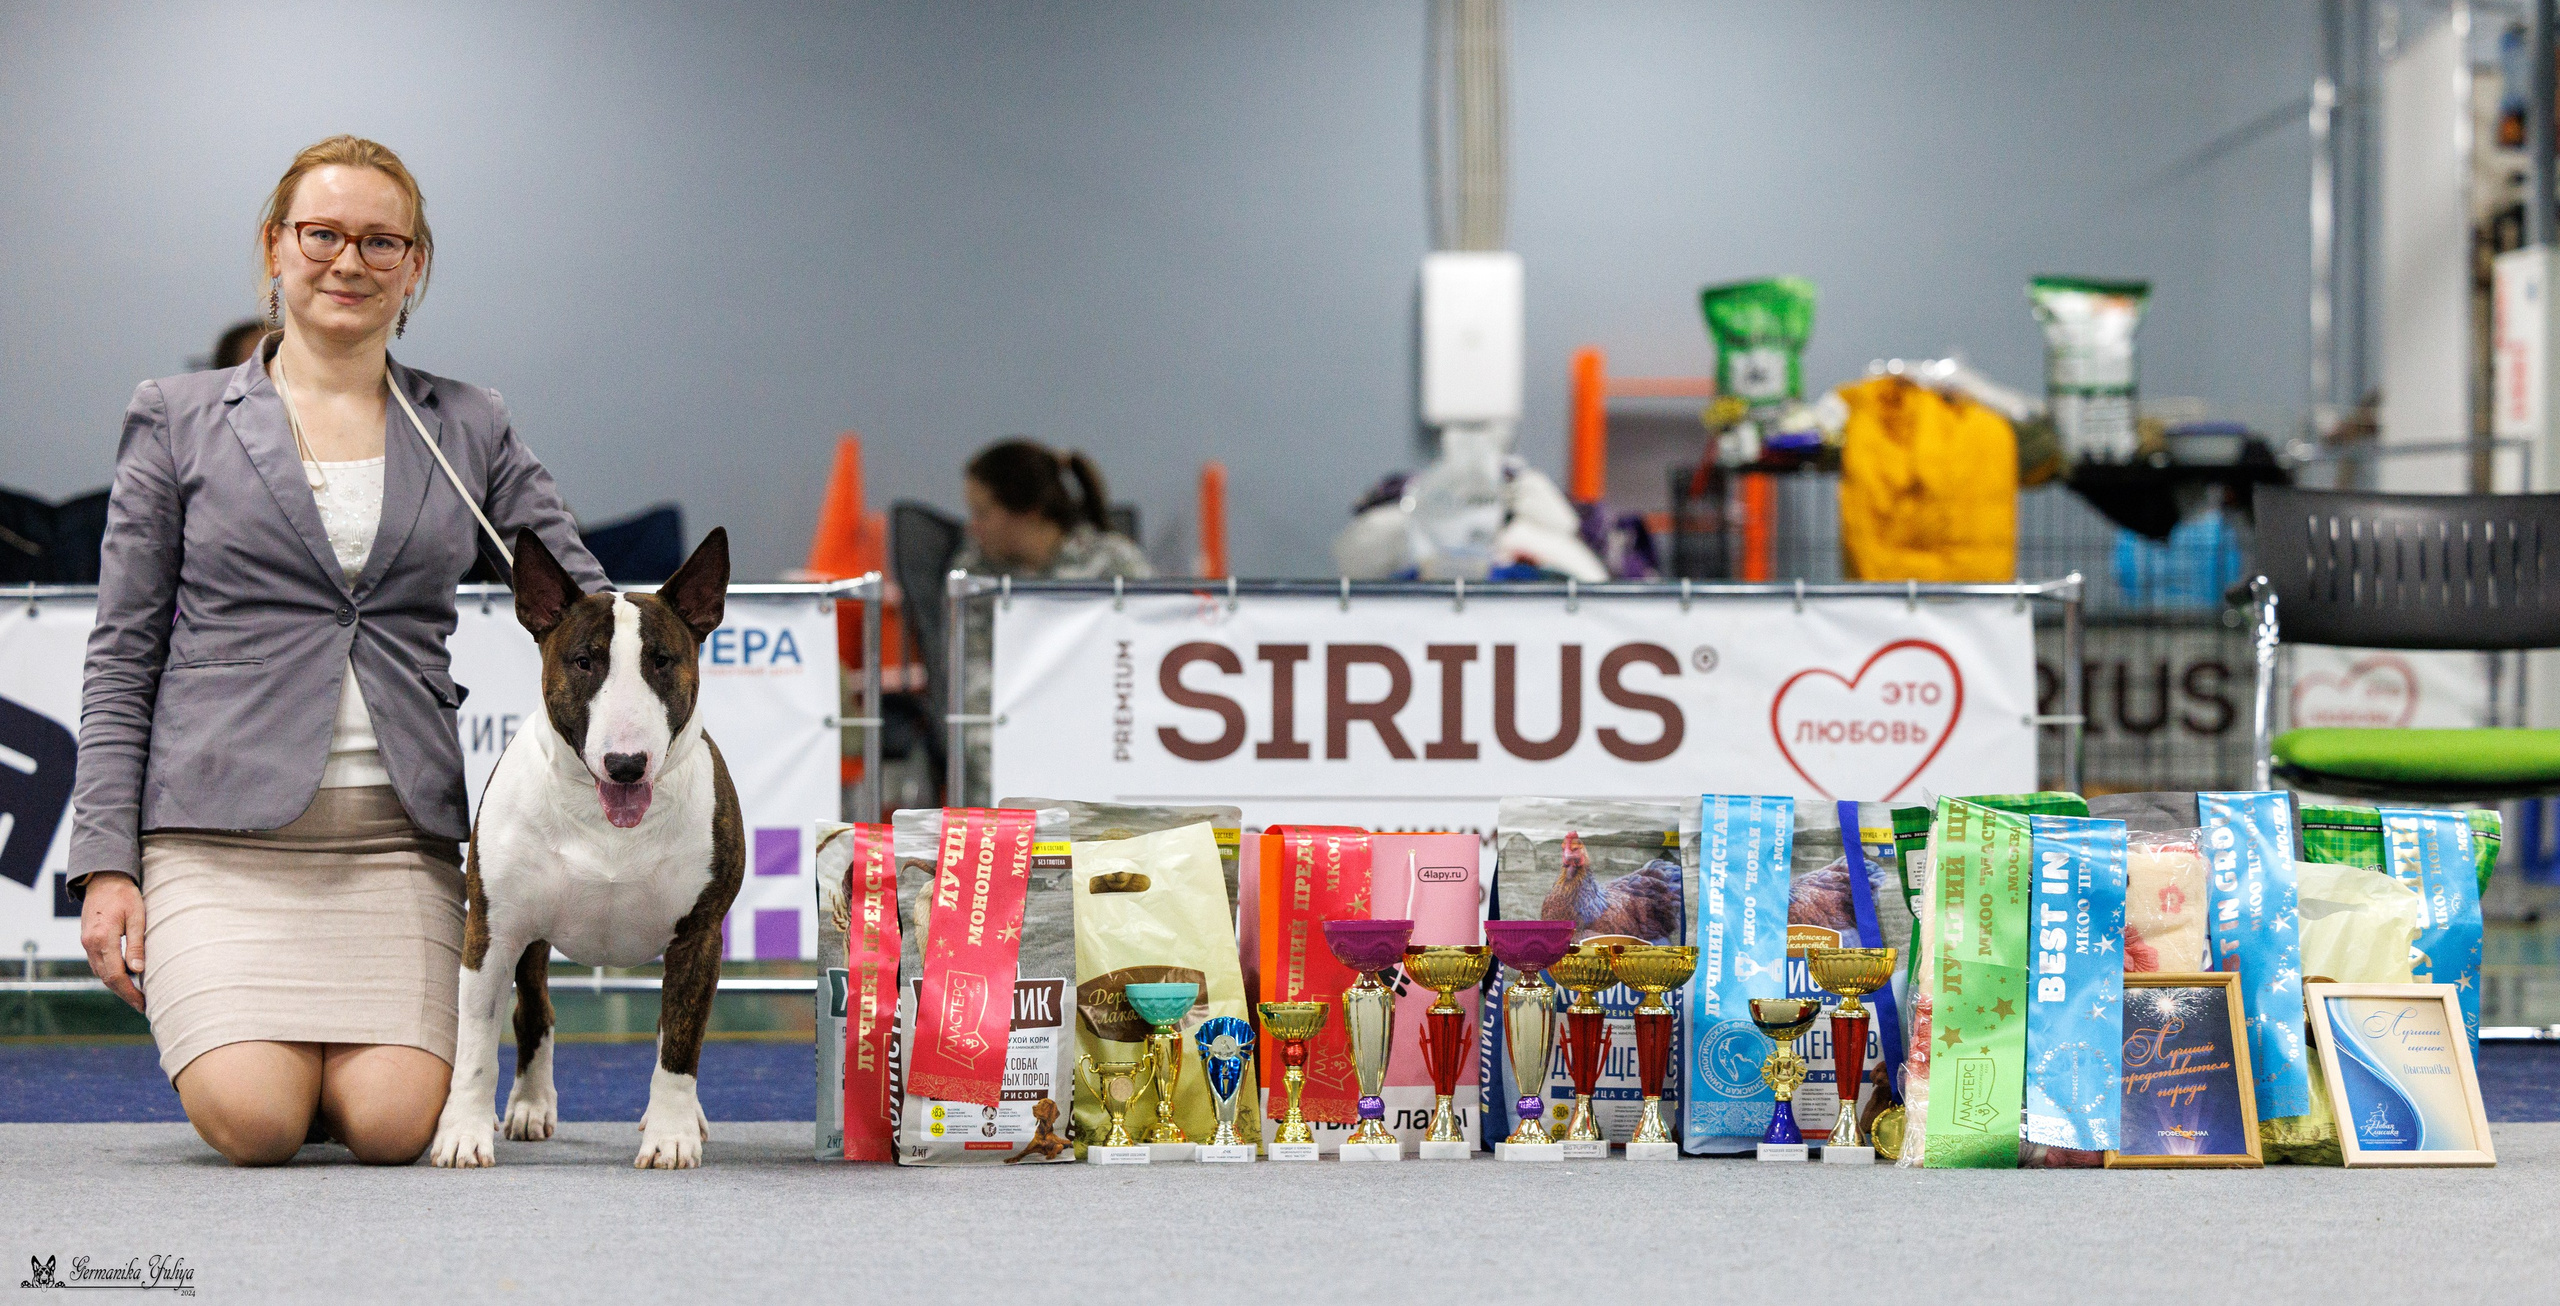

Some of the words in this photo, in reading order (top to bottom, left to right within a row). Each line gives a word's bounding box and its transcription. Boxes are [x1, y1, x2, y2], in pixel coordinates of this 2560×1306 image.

[699, 627, 802, 665] ЕРА
[1114, 639, 1133, 762] PREMIUM
[1157, 640, 1686, 762] SIRIUS
[1881, 682, 1942, 705] ЭТО
[1795, 720, 1928, 744] ЛЮБОВЬ
[1708, 794, 1730, 917] ПРЕДСТАВИ
[1773, 804, 1787, 872] г.МОСКВА
[1883, 848, 1894, 856] БЕЗ
[1979, 808, 1997, 887] "МАСТЕ
[2272, 796, 2291, 872] г.МОСКВА
[1326, 836, 1342, 894] МКОО
[1423, 870, 1462, 880] 4lapy.ru
[2007, 826, 2022, 905] г.МОСКВА
[2041, 851, 2070, 895] IN
[1743, 896, 1757, 946] МКОО
[1939, 855, 1966, 996] ЛУЧШИЙ
[1978, 893, 1994, 957] МКОО
[2075, 897, 2091, 956] МКОО
[2219, 896, 2240, 932] IN
[2249, 881, 2264, 932] МКОО
[2430, 882, 2450, 931] МКОО
[1704, 920, 1724, 1017] ЛУЧШИЙ
[2037, 902, 2070, 1003] BEST
[857, 959, 878, 1073] ЛУЧШИЙ
[944, 977, 968, 1052] МАСТЕРС
[1029, 1036, 1050, 1044] КОРМ
[2362, 1006, 2442, 1044] Лучший
[1010, 1057, 1038, 1071] СОБАК
[1701, 1023, 1731, 1091] КИНОЛОГИЧЕСКАЯ
[2122, 1017, 2215, 1068] Лучший
[2407, 1045, 2445, 1053] щенок
[1003, 1091, 1038, 1100] РИСОМ
[1022, 1072, 1050, 1088] ПОРОД
[1959, 1063, 1976, 1123] МАСТЕРС
[2157, 1082, 2208, 1108] породы
